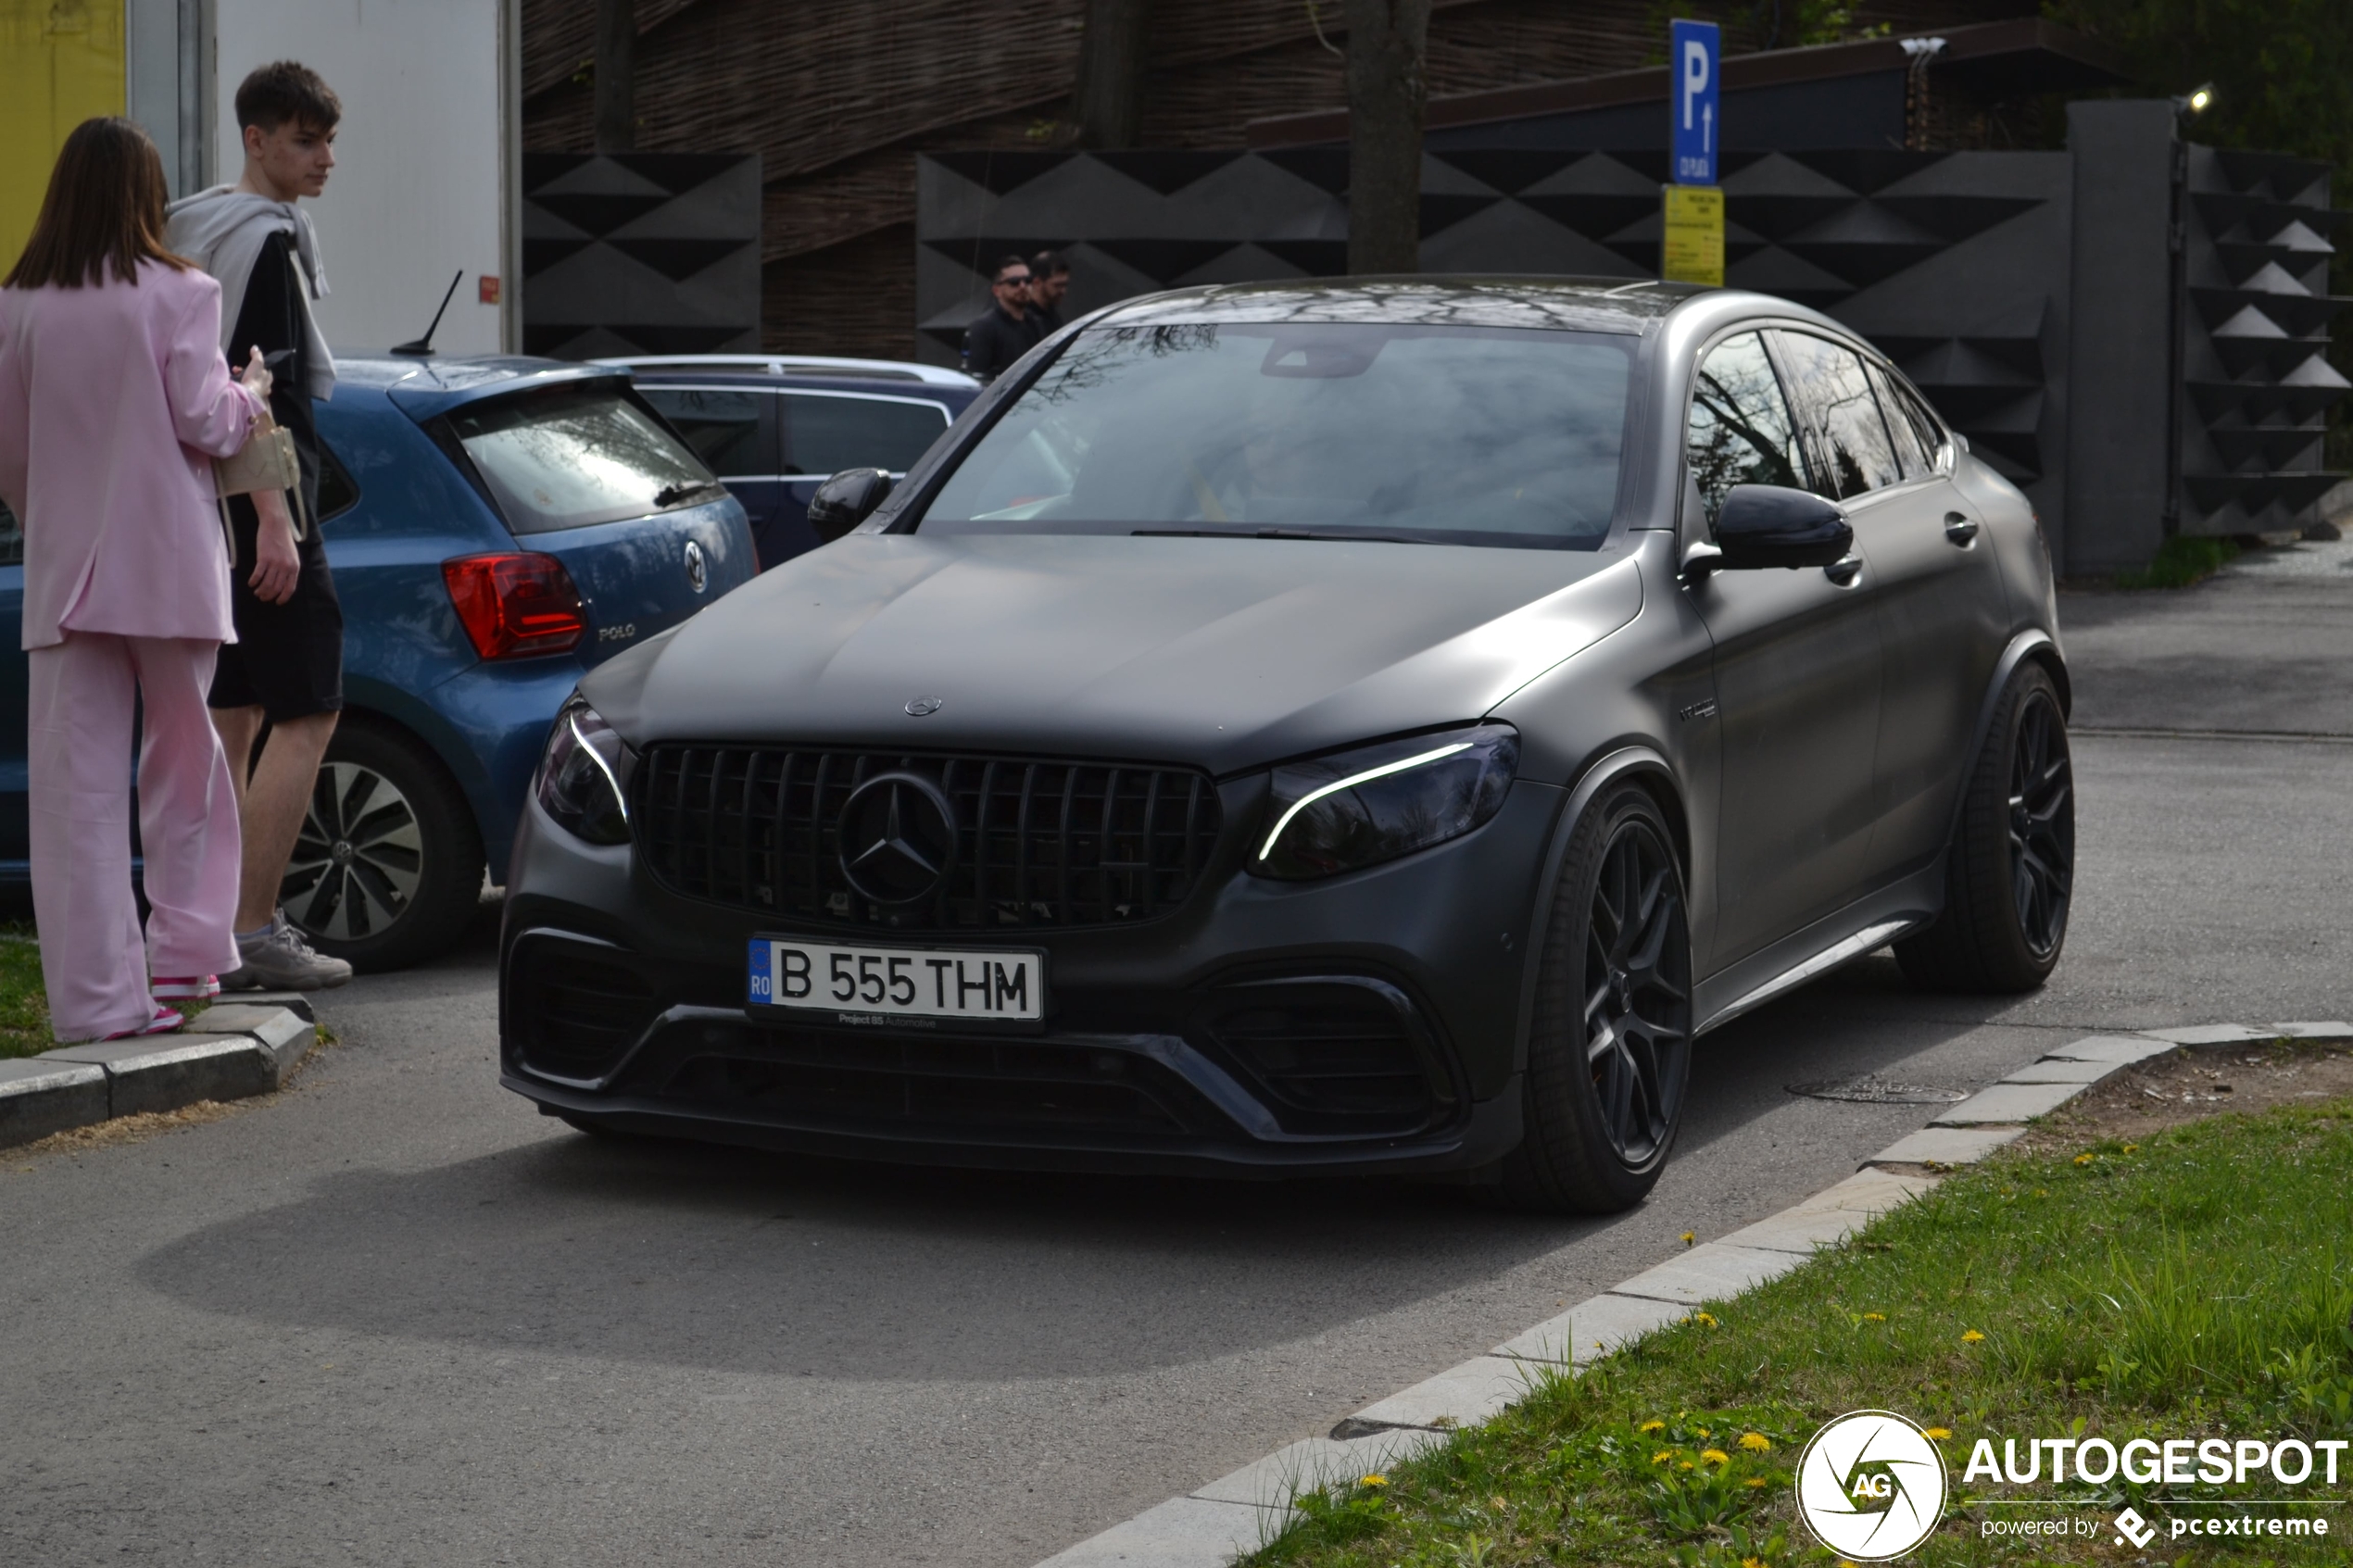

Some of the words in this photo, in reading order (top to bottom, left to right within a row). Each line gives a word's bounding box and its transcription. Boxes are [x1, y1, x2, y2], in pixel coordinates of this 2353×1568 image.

[1683, 40, 1709, 130] P
[598, 623, 635, 641] POLO
[751, 975, 771, 996] RO
[781, 949, 812, 998] B
[830, 953, 916, 1006] 555
[925, 959, 1027, 1011] THM
[838, 1013, 871, 1025] Project
[871, 1016, 884, 1025] 85
[885, 1017, 937, 1029] Automotive
